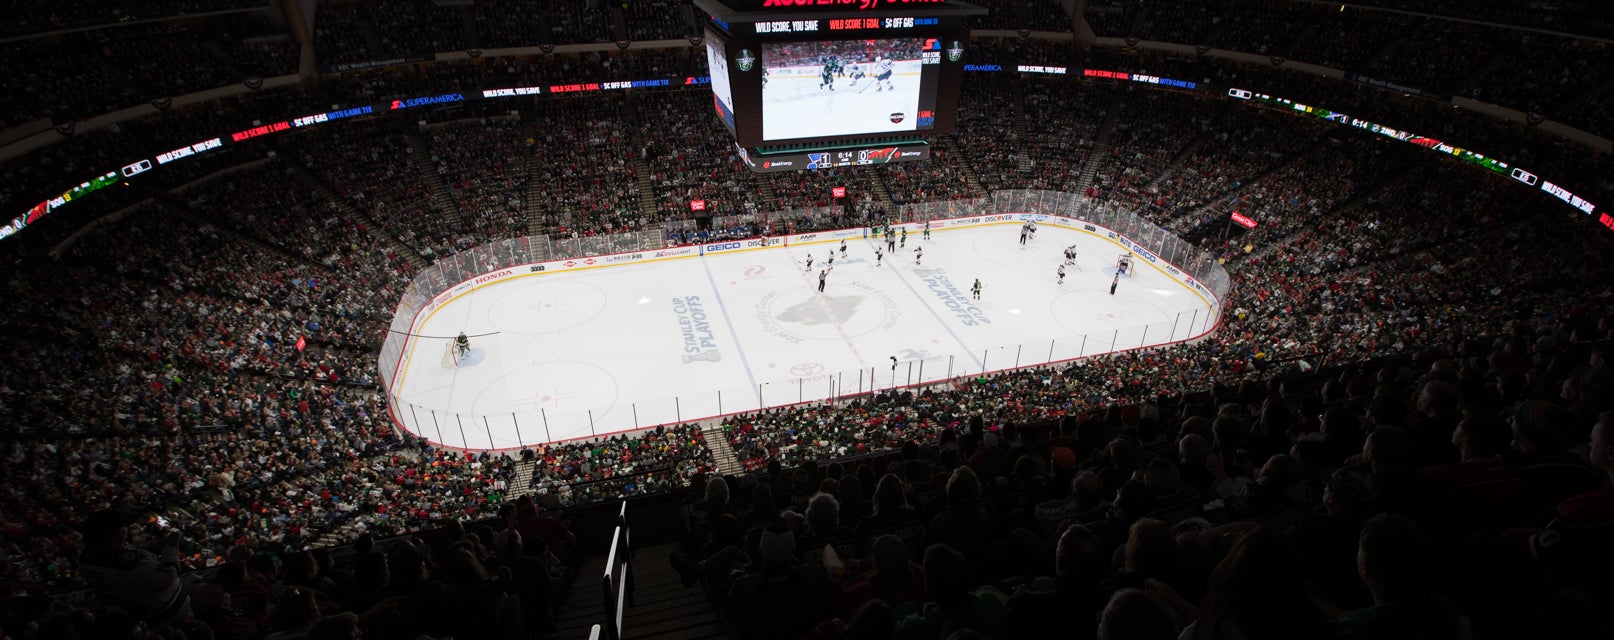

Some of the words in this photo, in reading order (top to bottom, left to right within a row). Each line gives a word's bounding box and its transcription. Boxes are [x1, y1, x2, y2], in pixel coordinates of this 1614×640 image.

[755, 22, 771, 33] WILD
[772, 21, 792, 32] SCORE,
[792, 20, 804, 31] YOU
[804, 20, 819, 31] SAVE
[830, 19, 844, 30] WILD
[845, 18, 862, 29] SCORE
[866, 18, 880, 29] GOAL
[893, 17, 903, 28] OFF
[903, 17, 914, 28] GAS
[1017, 65, 1030, 73] WILD
[1044, 66, 1055, 74] YOU
[1055, 67, 1067, 75] SAVE
[549, 85, 564, 93] WILD
[565, 84, 582, 92] SCORE
[610, 81, 621, 89] OFF
[621, 80, 632, 89] GAS
[631, 80, 646, 88] WITH
[645, 79, 660, 88] GAME
[1084, 69, 1097, 77] WILD
[1097, 70, 1113, 79] SCORE
[1140, 75, 1149, 83] OFF
[1149, 76, 1160, 84] GAS
[1160, 77, 1173, 87] WITH
[1172, 79, 1188, 88] GAME
[1187, 82, 1197, 90] TIX
[482, 89, 497, 98] WILD
[514, 87, 526, 96] YOU
[526, 86, 540, 95] SAVE
[405, 93, 465, 107] SUPERAMERICA
[232, 128, 249, 142] WILD
[248, 123, 270, 138] SCORE
[273, 120, 291, 132] GOAL
[302, 115, 315, 126] OFF
[314, 112, 328, 123] GAS
[327, 110, 344, 121] WITH
[343, 107, 363, 118] GAME
[361, 105, 373, 115] TIX
[1352, 118, 1369, 130] 6:14
[1380, 127, 1397, 138] 2ND
[156, 152, 174, 165] WILD
[191, 142, 207, 153] YOU
[204, 137, 223, 150] SAVE
[1440, 143, 1454, 154] SOG
[50, 196, 66, 209] SOG
[1541, 180, 1558, 196] WILD
[1570, 195, 1586, 209] YOU
[1579, 200, 1596, 215] SAVE
[984, 214, 1013, 223] DISCOVER
[706, 242, 741, 252] GEICO
[1133, 244, 1156, 263] GEICO
[475, 270, 514, 284] HONDA
[672, 297, 688, 314] CUP
[921, 279, 979, 326] PLAYOFFS
[685, 295, 717, 348] PLAYOFFS
[967, 306, 992, 324] CUP
[677, 314, 700, 353] STANLEY
